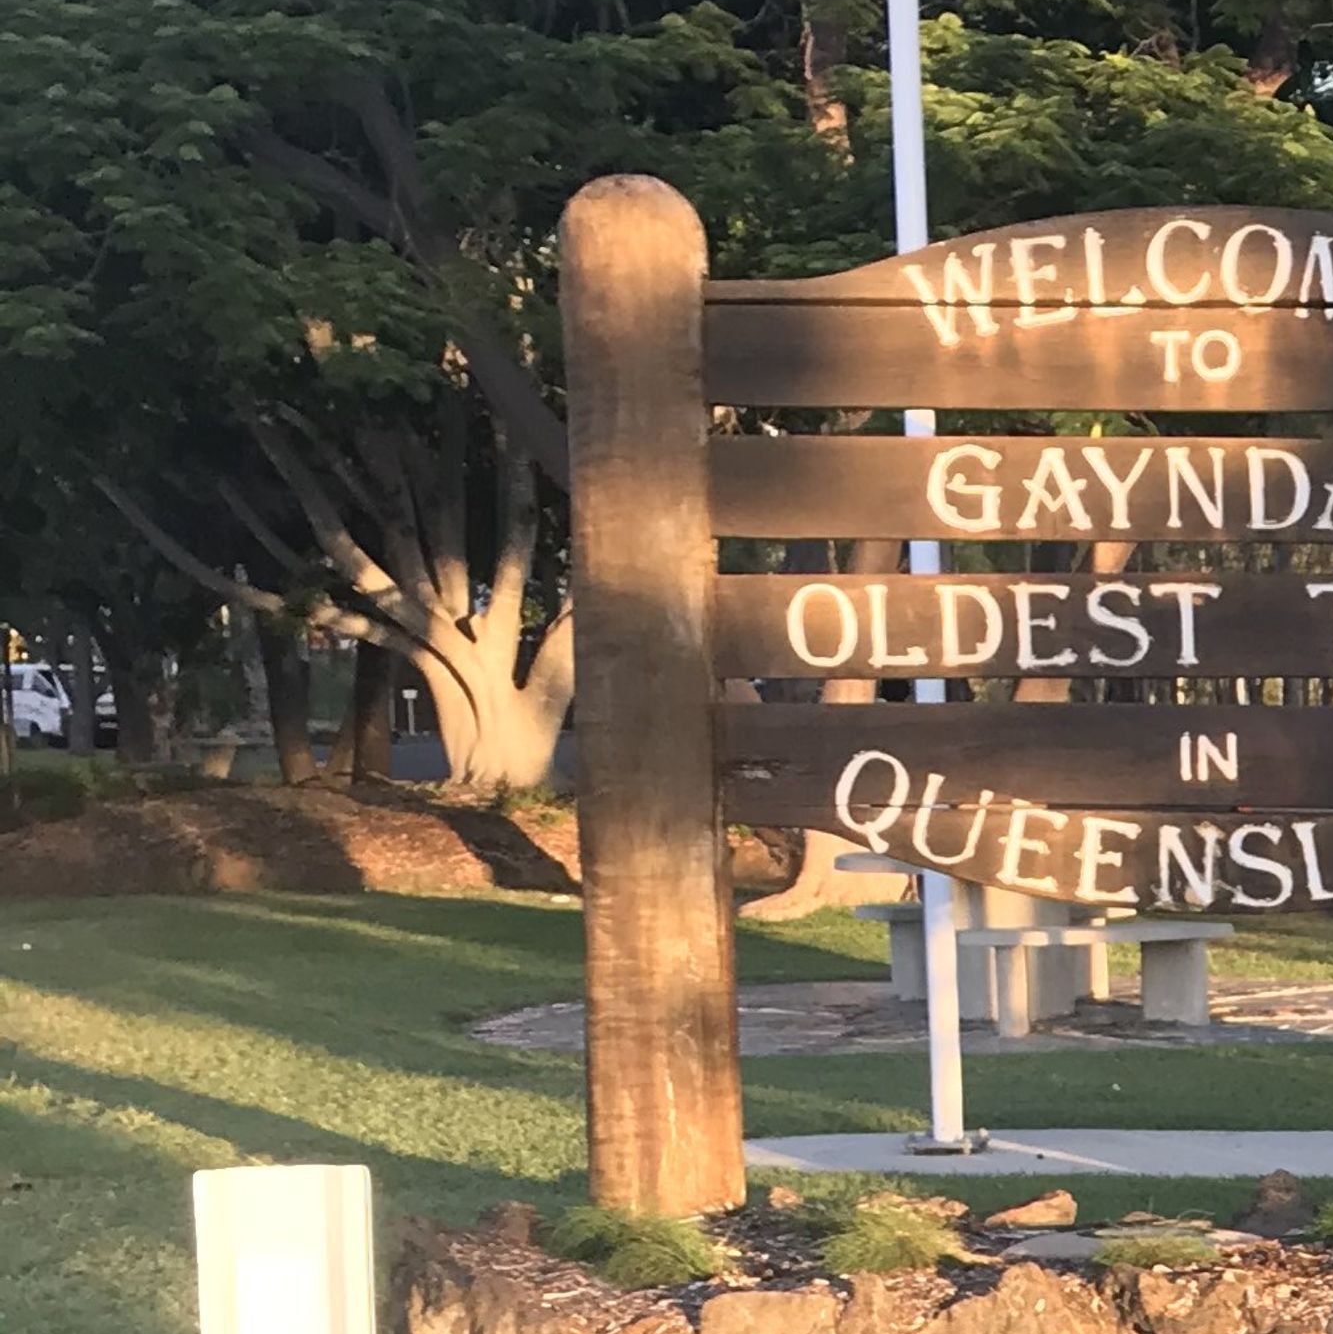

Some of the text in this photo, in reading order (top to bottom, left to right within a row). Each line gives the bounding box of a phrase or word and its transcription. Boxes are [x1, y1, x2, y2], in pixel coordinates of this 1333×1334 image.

[1152, 330, 1240, 382] TO
[787, 581, 1222, 668] OLDEST
[1179, 731, 1238, 782] IN
